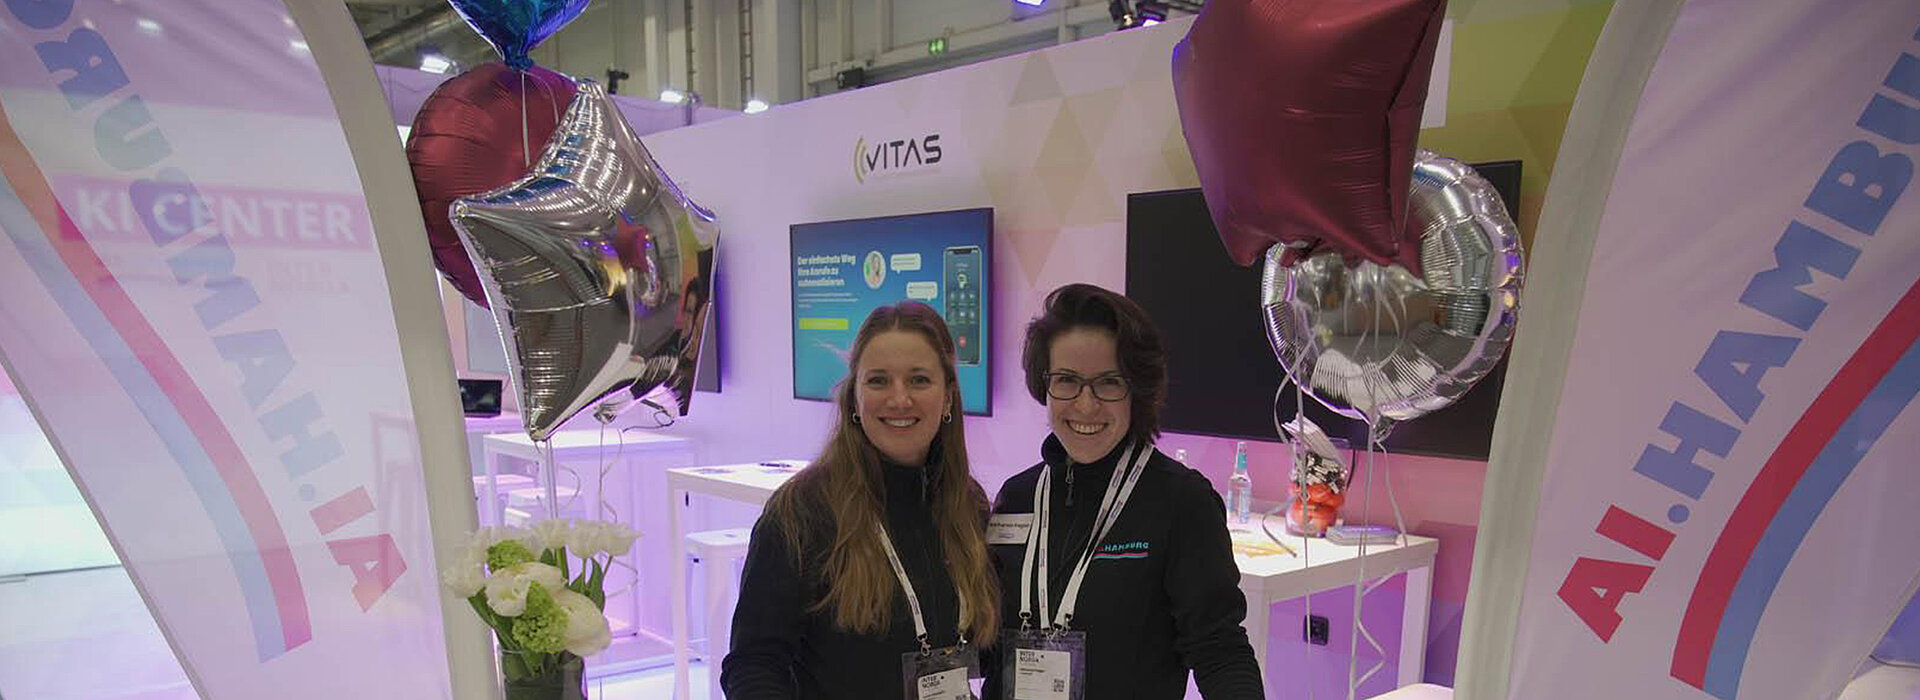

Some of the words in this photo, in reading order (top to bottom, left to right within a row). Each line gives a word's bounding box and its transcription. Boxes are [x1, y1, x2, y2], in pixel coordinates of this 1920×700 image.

[866, 133, 943, 172] VITAS
[75, 187, 134, 233] KI
[152, 191, 357, 244] CENTER
[841, 253, 857, 266] Weg
[1557, 22, 1920, 644] AI.HAMBU
